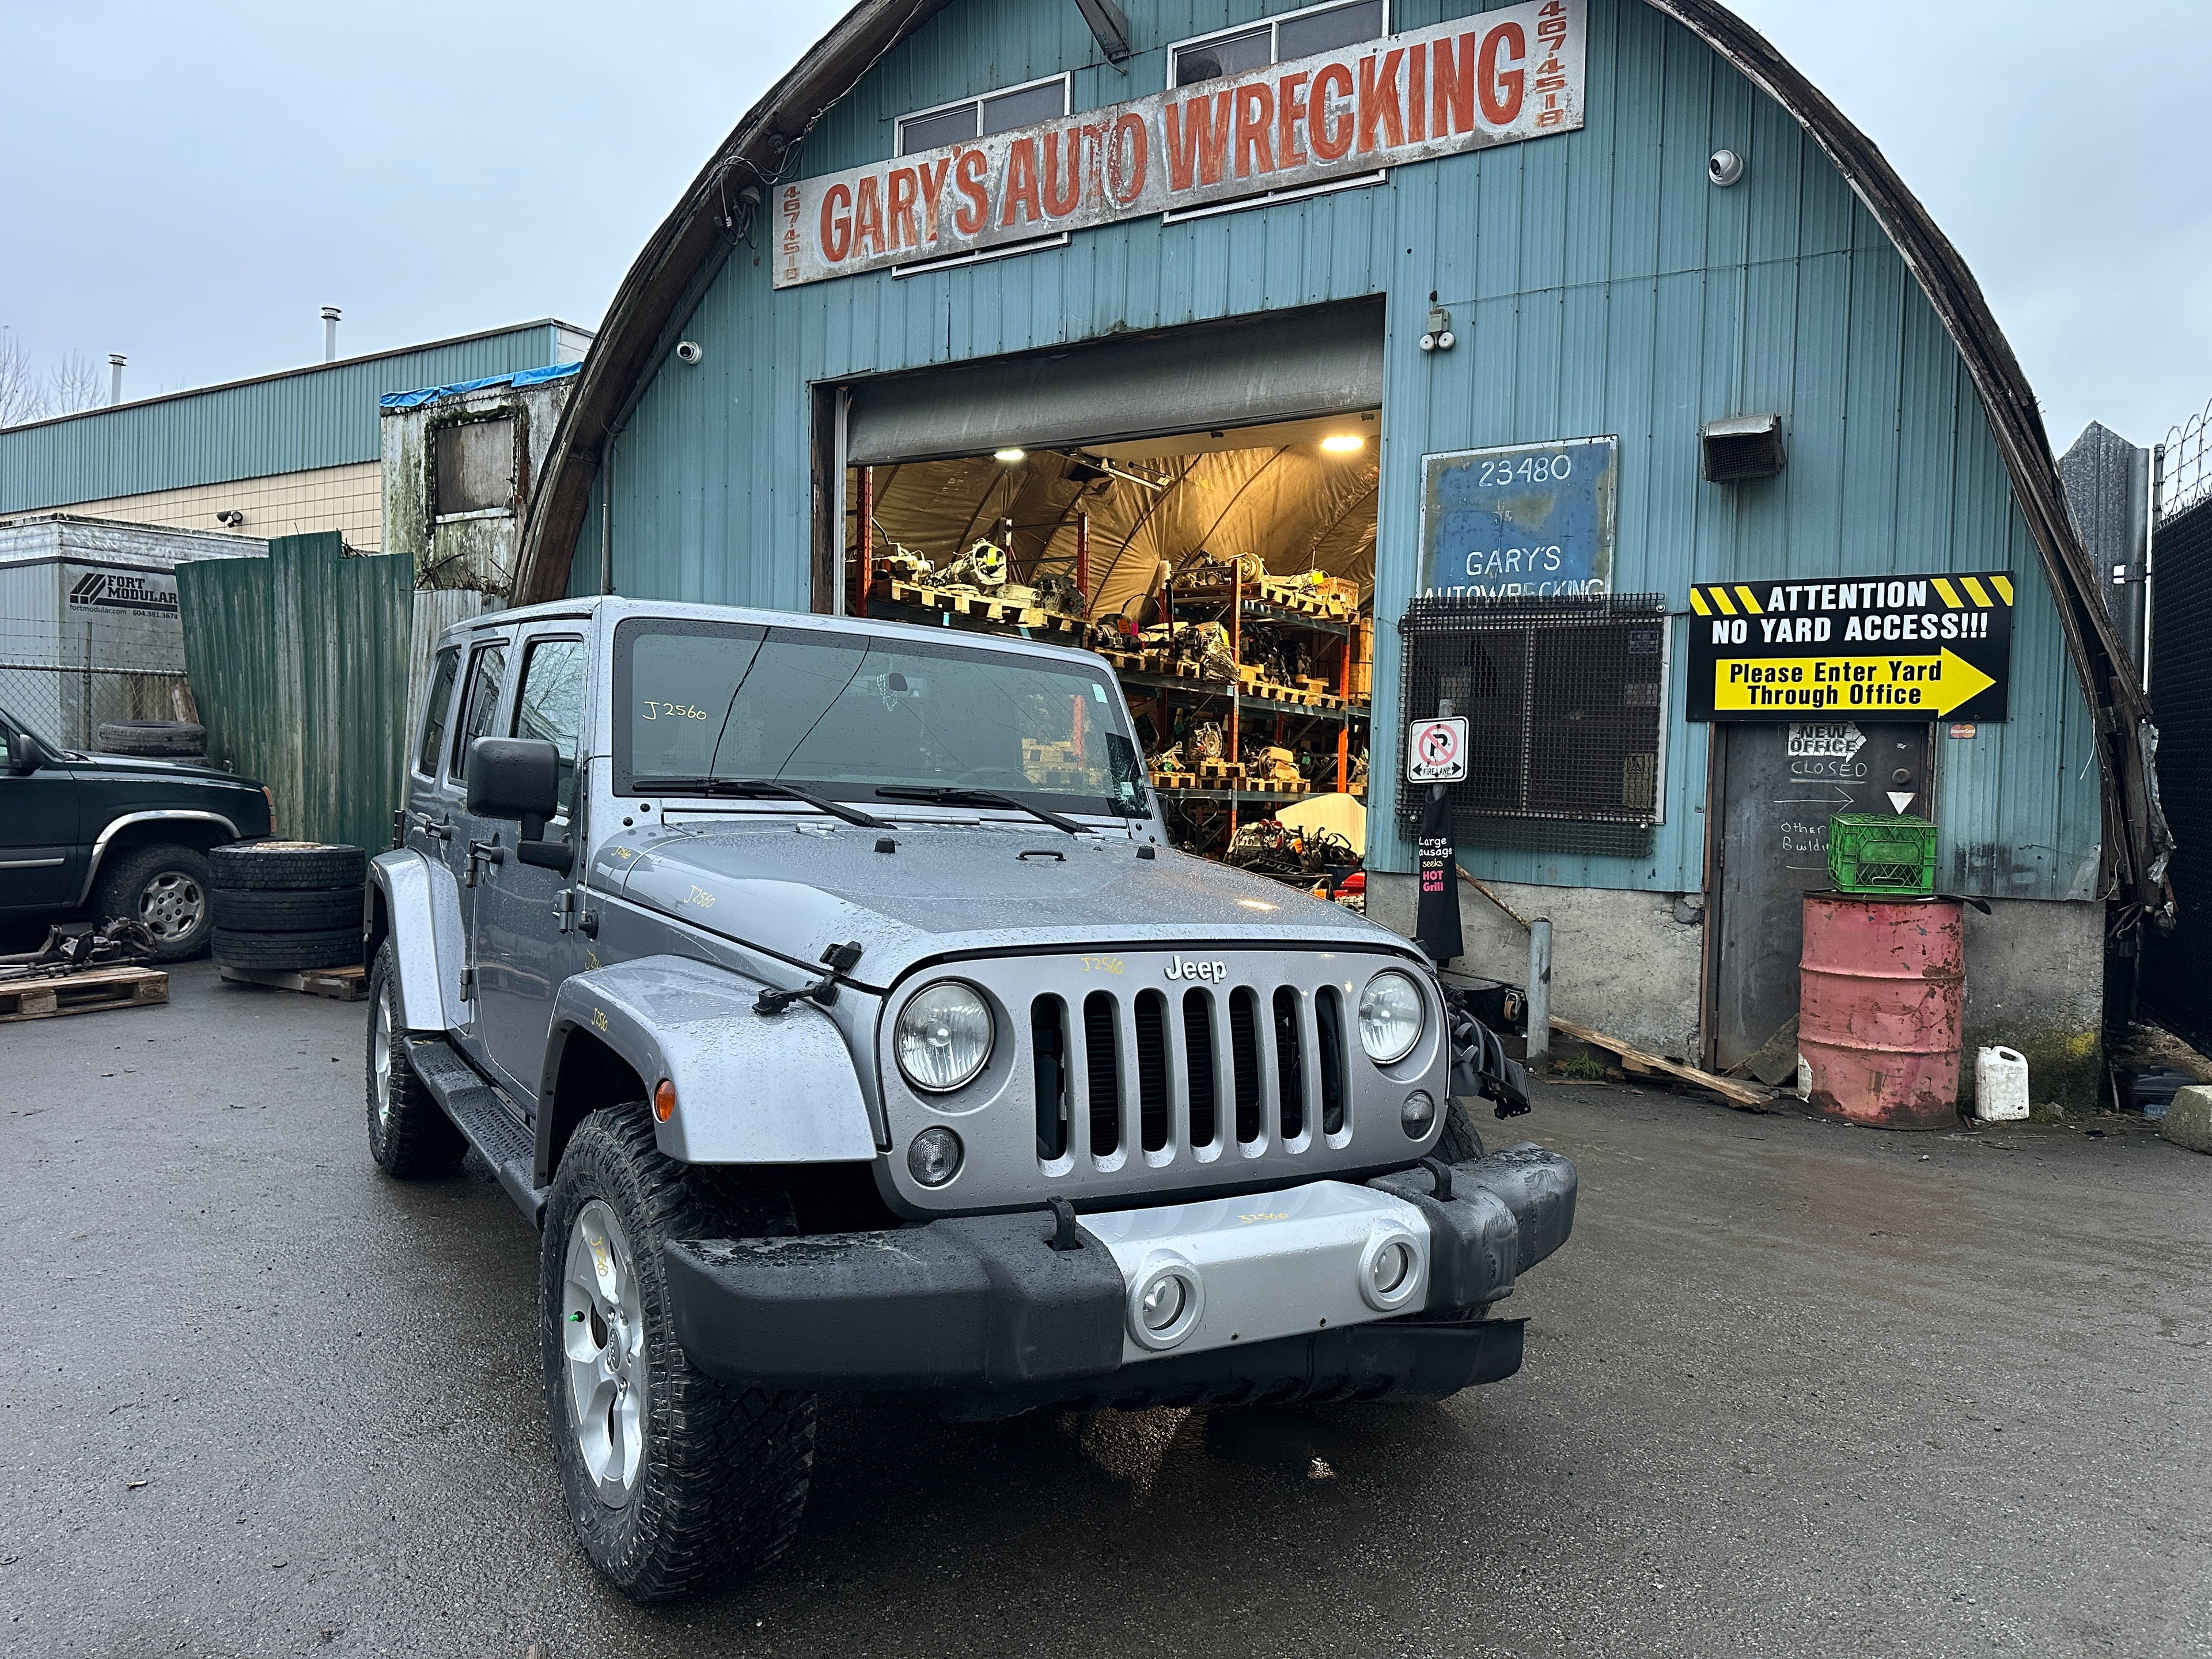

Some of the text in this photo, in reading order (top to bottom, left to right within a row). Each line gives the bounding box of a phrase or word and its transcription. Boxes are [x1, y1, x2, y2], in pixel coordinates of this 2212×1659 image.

[820, 22, 1526, 263] GARY'S AUTO WRECKING
[1479, 454, 1571, 487] 23480
[1466, 545, 1561, 575] GARY'S
[107, 575, 145, 589] FORT
[107, 586, 178, 604] MODULAR
[1767, 581, 1927, 611] ATTENTION
[70, 604, 178, 620] fortmodular.com 604.381.3678
[1711, 612, 1988, 644] NO YARD ACCESS!!!
[1730, 660, 1942, 683] Please Enter Yard
[1747, 684, 1921, 708] Through Office
[642, 701, 707, 721] J2560
[1800, 724, 1845, 738] NEW
[1790, 738, 1857, 752] OFFICE
[1423, 768, 1435, 776] FIRE
[1791, 760, 1868, 777] CLOSED
[1419, 836, 1447, 848] Large
[1419, 847, 1453, 858] ausage
[1422, 858, 1443, 868] seeks
[1423, 870, 1444, 880] HOT
[1423, 882, 1444, 892] Grill
[684, 885, 715, 908] J2560
[1081, 957, 1124, 975] J2560
[1164, 955, 1228, 984] Jeep
